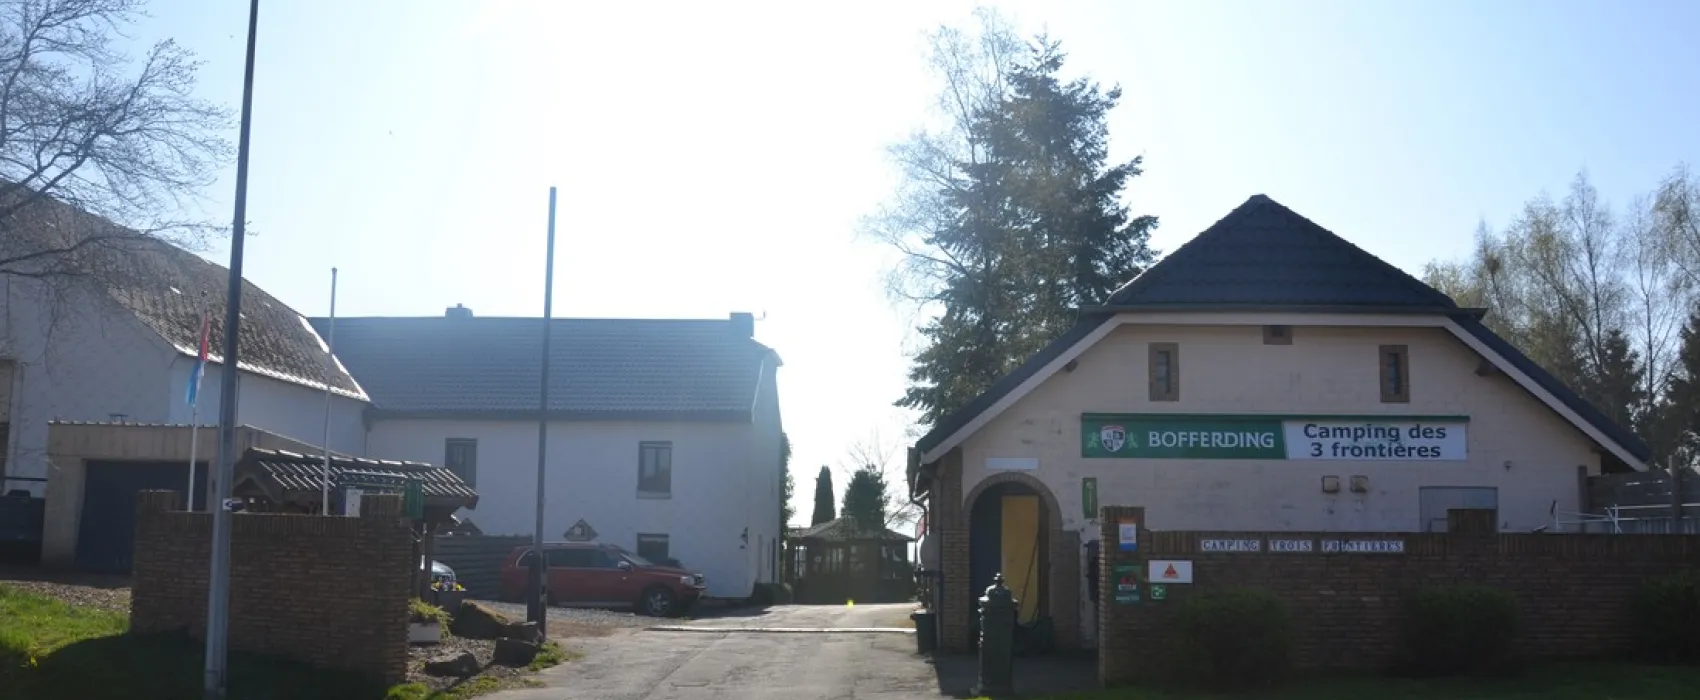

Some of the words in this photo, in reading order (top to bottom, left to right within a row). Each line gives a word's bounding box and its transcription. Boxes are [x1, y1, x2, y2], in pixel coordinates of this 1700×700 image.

[1148, 431, 1275, 448] BOFFERDING
[1303, 423, 1400, 442] Camping
[1408, 424, 1447, 439] des
[1310, 442, 1324, 457] 3
[1331, 441, 1441, 458] frontières
[1202, 540, 1259, 551] CAMPING
[1270, 540, 1311, 551] TROIS
